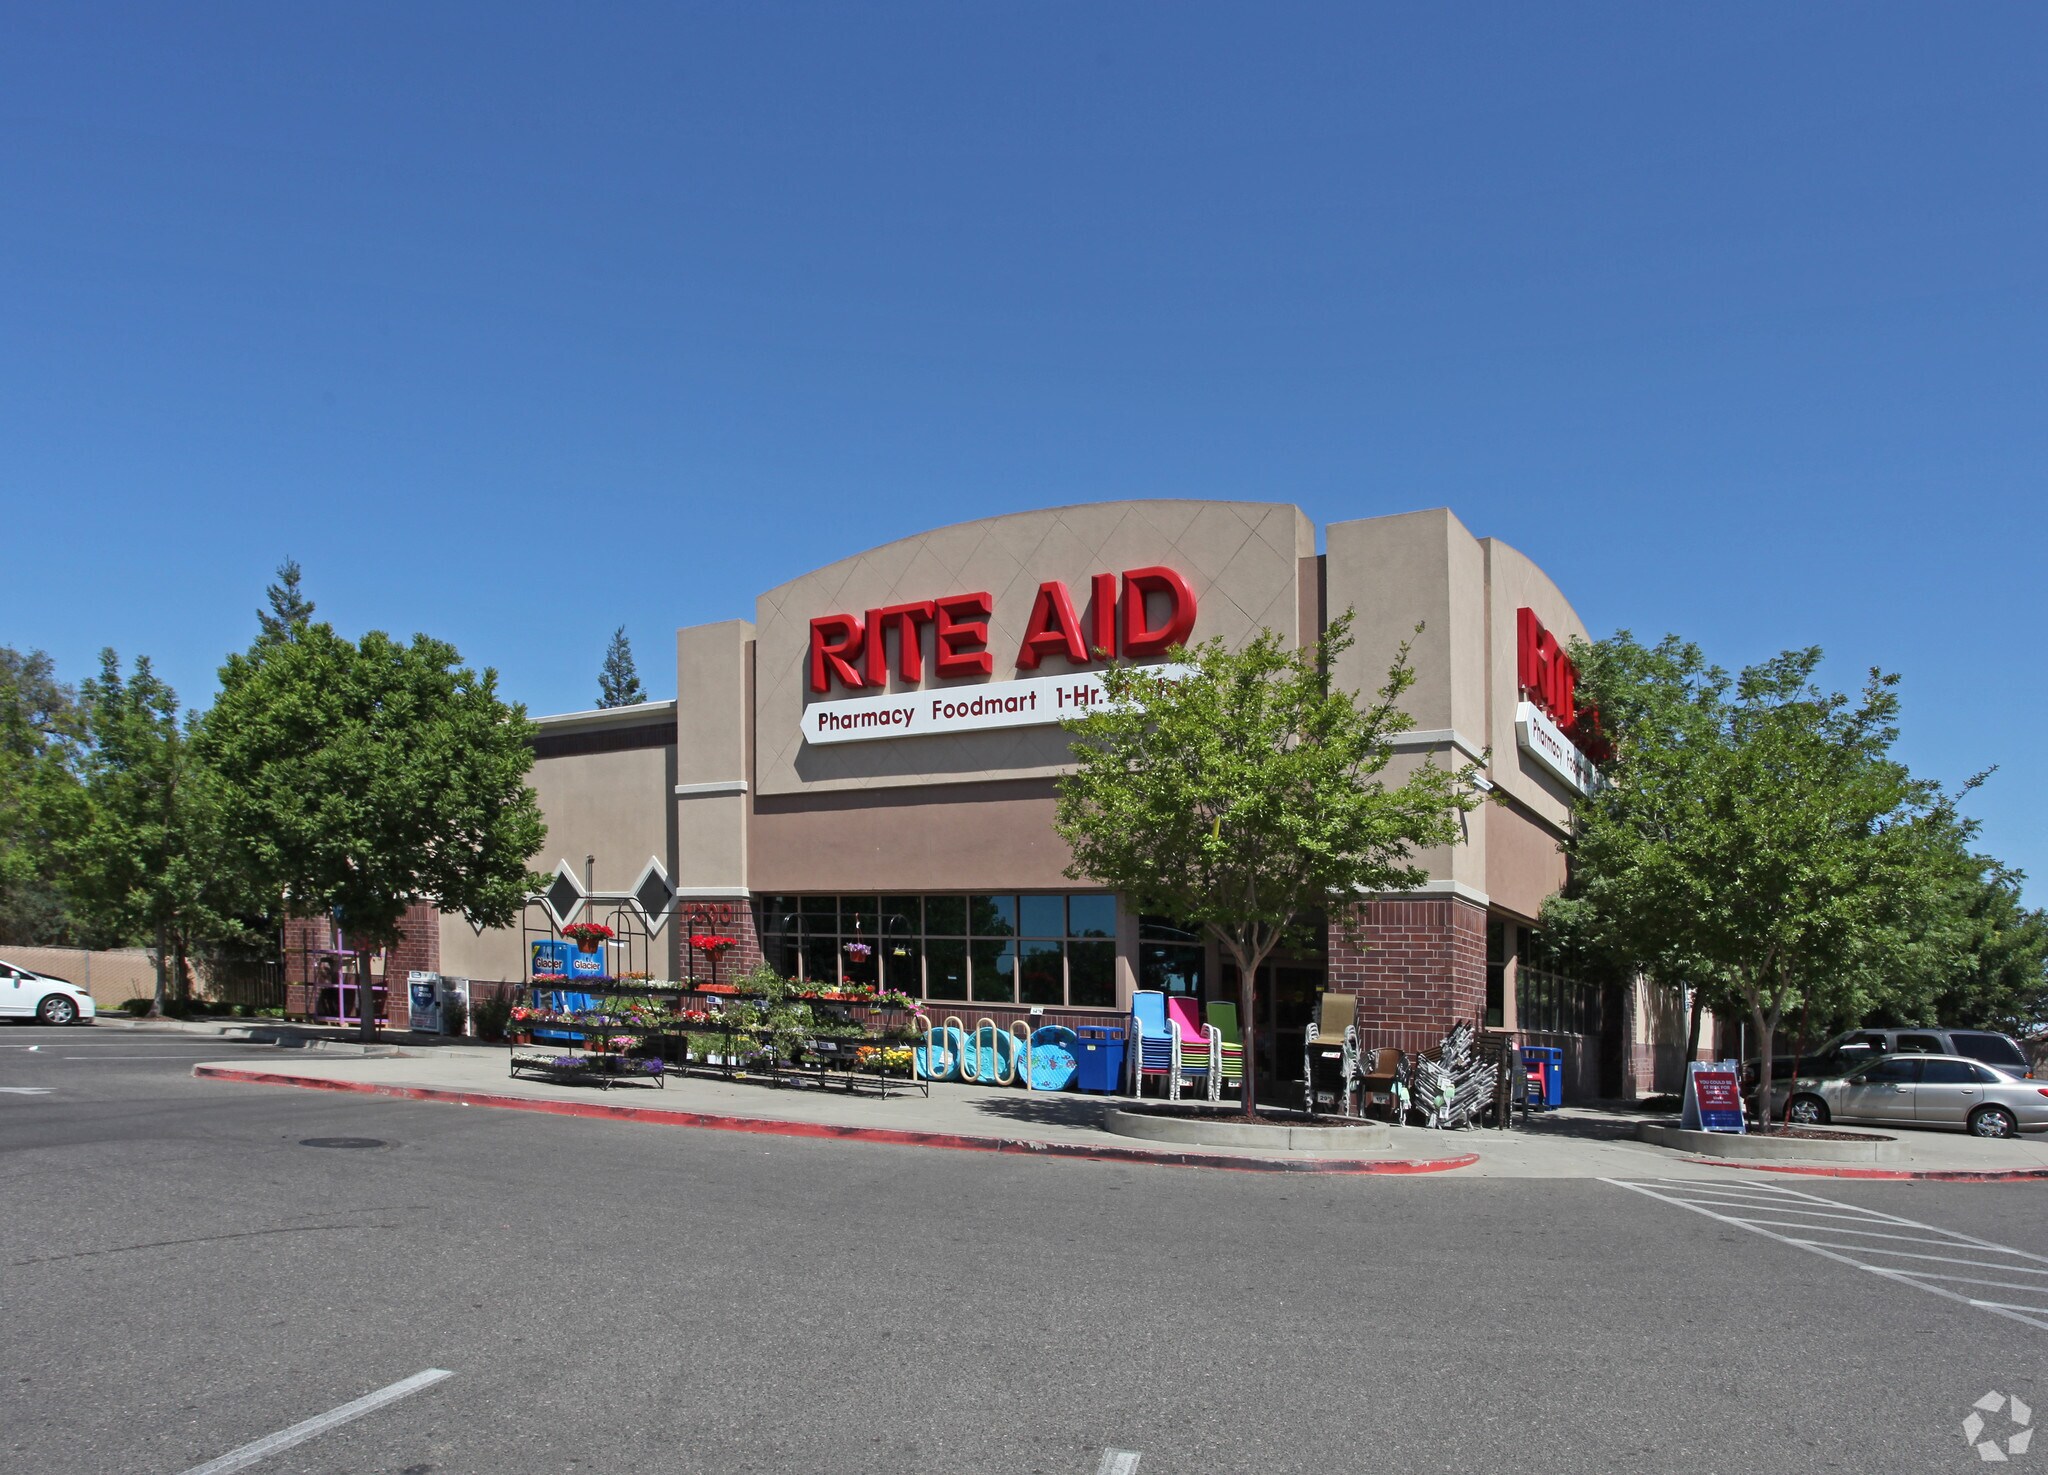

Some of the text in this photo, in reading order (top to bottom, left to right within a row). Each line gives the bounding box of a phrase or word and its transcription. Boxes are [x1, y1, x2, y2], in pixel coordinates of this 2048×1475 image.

[810, 566, 1198, 693] RITE AID
[818, 706, 915, 732] Pharmacy
[932, 690, 1037, 720] Foodmart
[1056, 684, 1103, 709] 1-Hr.
[1532, 718, 1564, 766] Pharmacy
[535, 957, 563, 969] Glacer
[574, 960, 601, 970] Glacier
